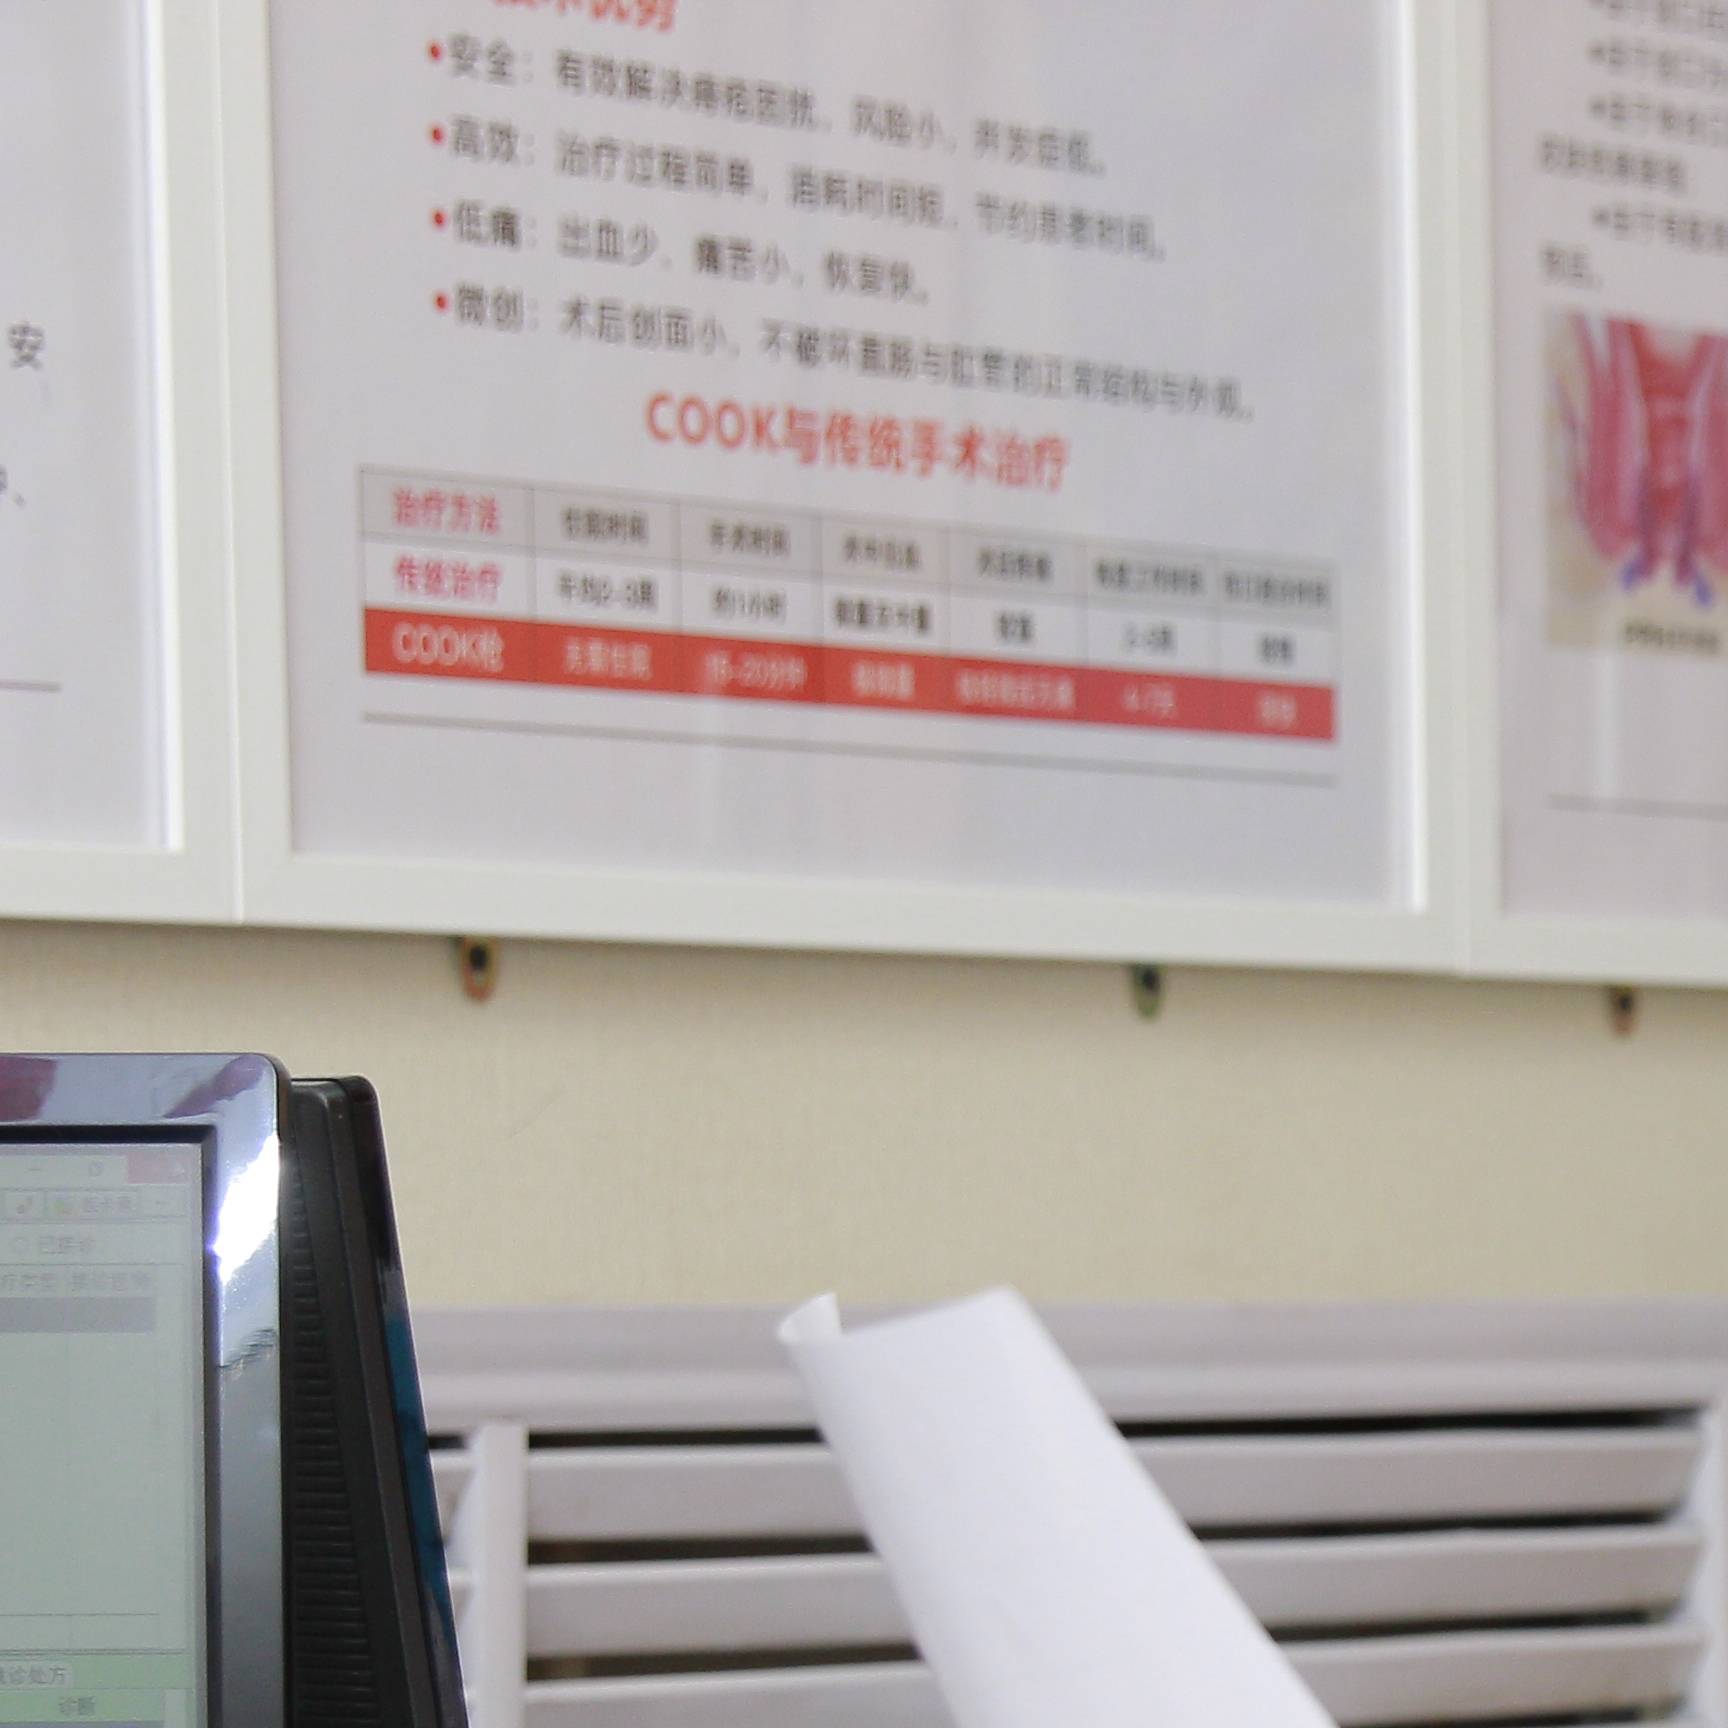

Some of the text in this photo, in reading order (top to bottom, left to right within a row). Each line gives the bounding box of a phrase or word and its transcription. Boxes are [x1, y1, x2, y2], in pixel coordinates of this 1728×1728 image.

[646, 394, 1070, 492] COOK与传统手术治疗
[393, 489, 499, 534] 治疗方法
[394, 556, 502, 601] 传统治疗
